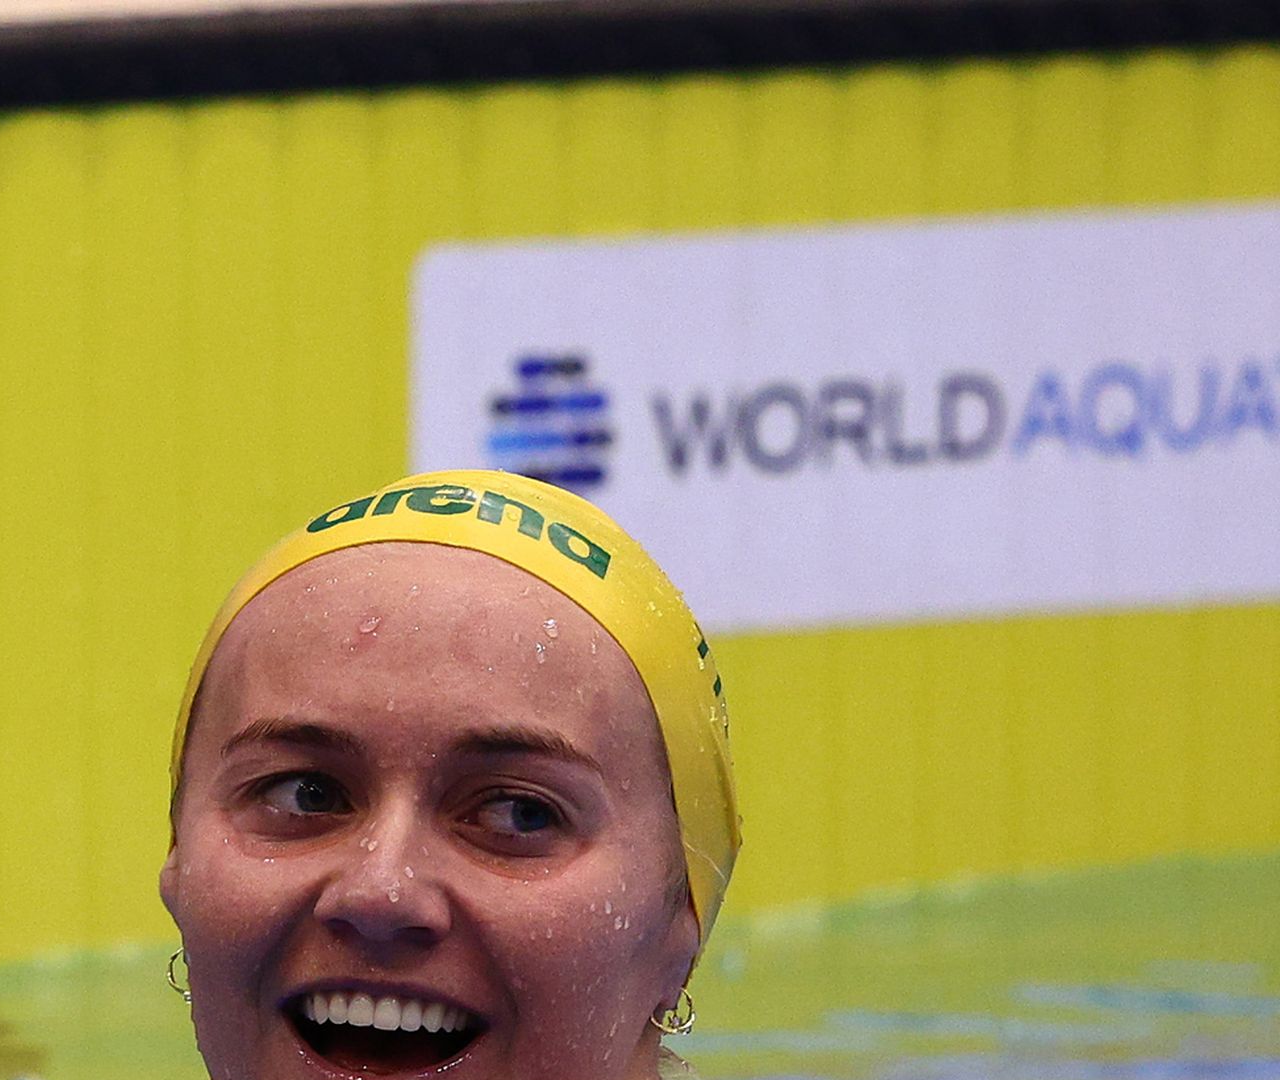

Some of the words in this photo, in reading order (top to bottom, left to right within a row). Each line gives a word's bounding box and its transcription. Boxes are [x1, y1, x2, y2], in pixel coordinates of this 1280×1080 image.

[652, 371, 1008, 476] WORLD
[1011, 358, 1280, 458] AQUA
[306, 484, 611, 580] arena
